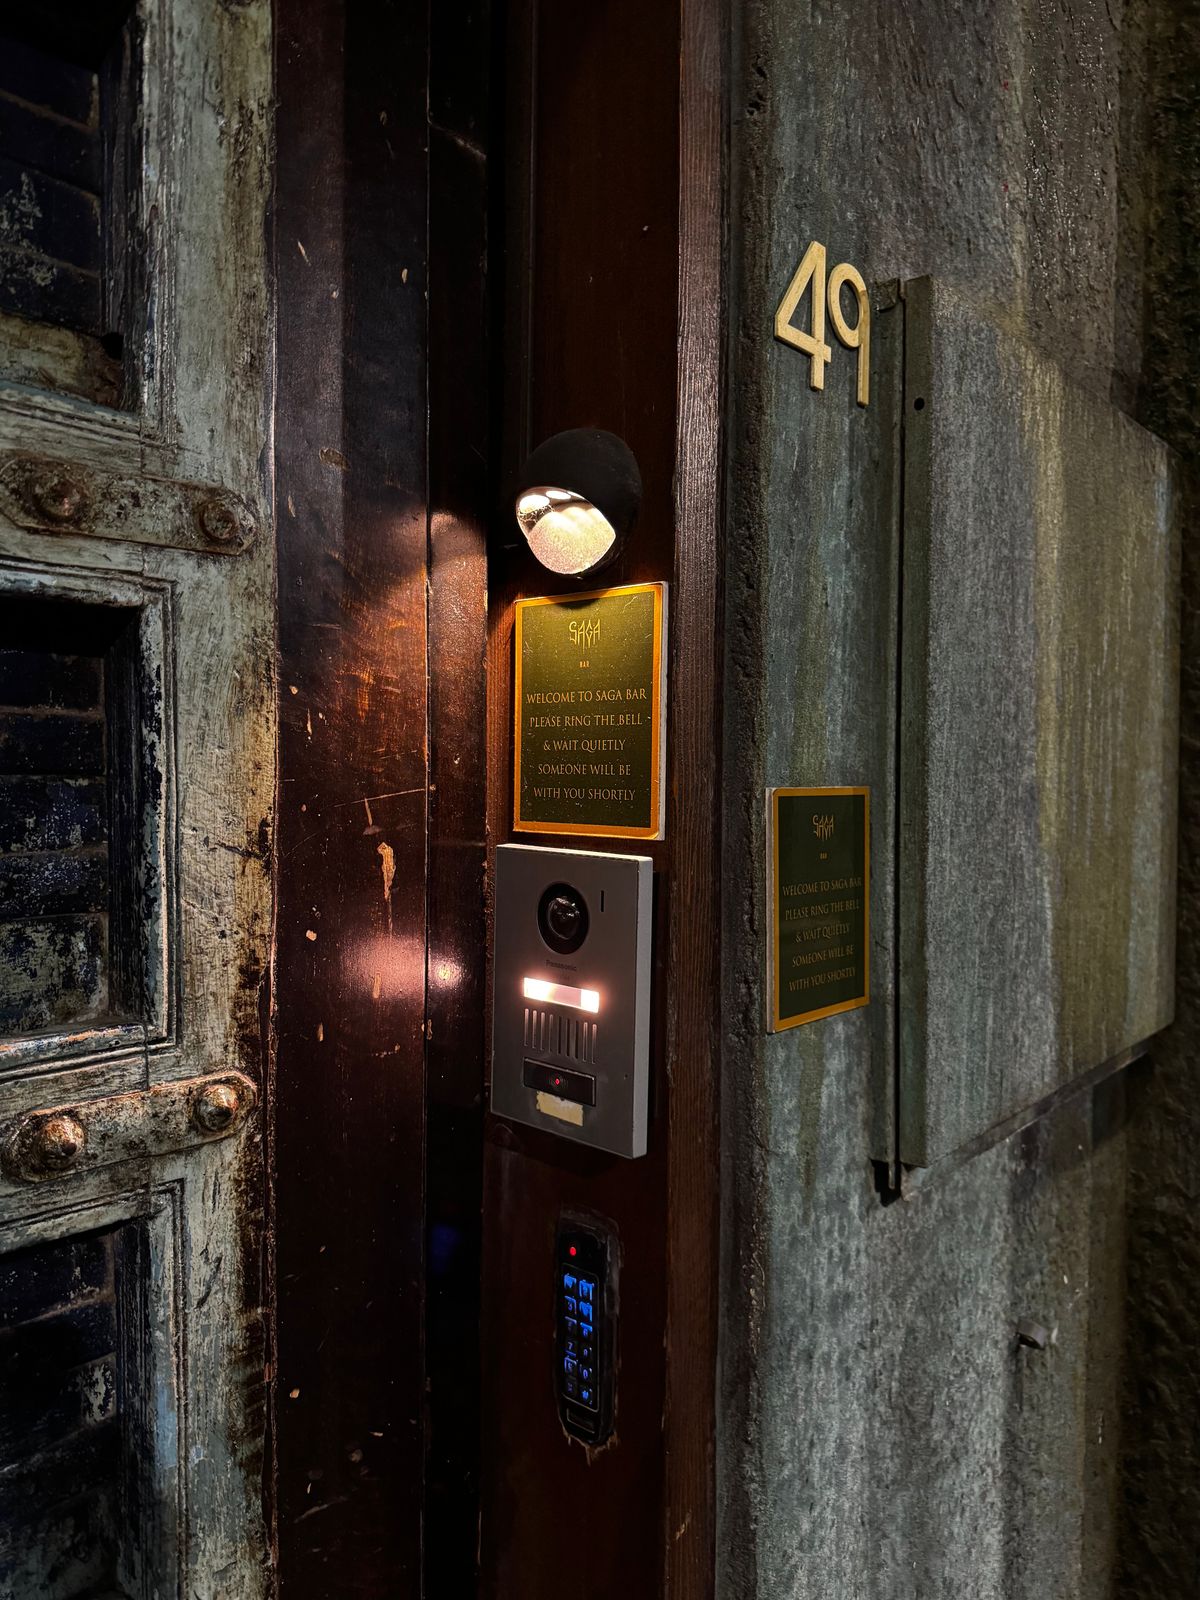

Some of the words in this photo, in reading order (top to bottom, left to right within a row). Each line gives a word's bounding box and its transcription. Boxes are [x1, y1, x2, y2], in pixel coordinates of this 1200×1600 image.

[774, 240, 871, 406] 49
[569, 618, 601, 655] SAGA
[526, 690, 575, 704] WELCOME
[578, 690, 593, 702] TO
[596, 688, 623, 702] SAGA
[625, 687, 647, 700] BAR
[529, 715, 562, 728] PLEASE
[564, 714, 591, 727] RING
[593, 714, 615, 726] THE
[619, 713, 643, 726] BELL
[543, 740, 551, 751] &
[553, 739, 579, 751] WAIT
[581, 739, 626, 753] QUIETLY
[538, 763, 587, 775] SOMEONE
[590, 763, 616, 776] WILL
[619, 764, 631, 776] BE
[533, 787, 560, 800] WITH
[563, 787, 585, 800] YOU
[588, 788, 636, 801] SHORTLY
[782, 881, 818, 897] WELCOME
[820, 880, 830, 893] TO
[831, 878, 848, 891] SAGA
[785, 906, 809, 921] PLEASE
[810, 903, 829, 917] RING
[831, 901, 845, 913] THE
[794, 933, 802, 944] &
[802, 928, 821, 941] WAIT
[822, 922, 850, 940] QUIETLY
[792, 950, 827, 968] SOMEONE
[828, 945, 844, 960] WILL
[789, 976, 810, 991] WITH
[810, 972, 827, 986] YOU
[827, 966, 856, 983] SHORTLY
